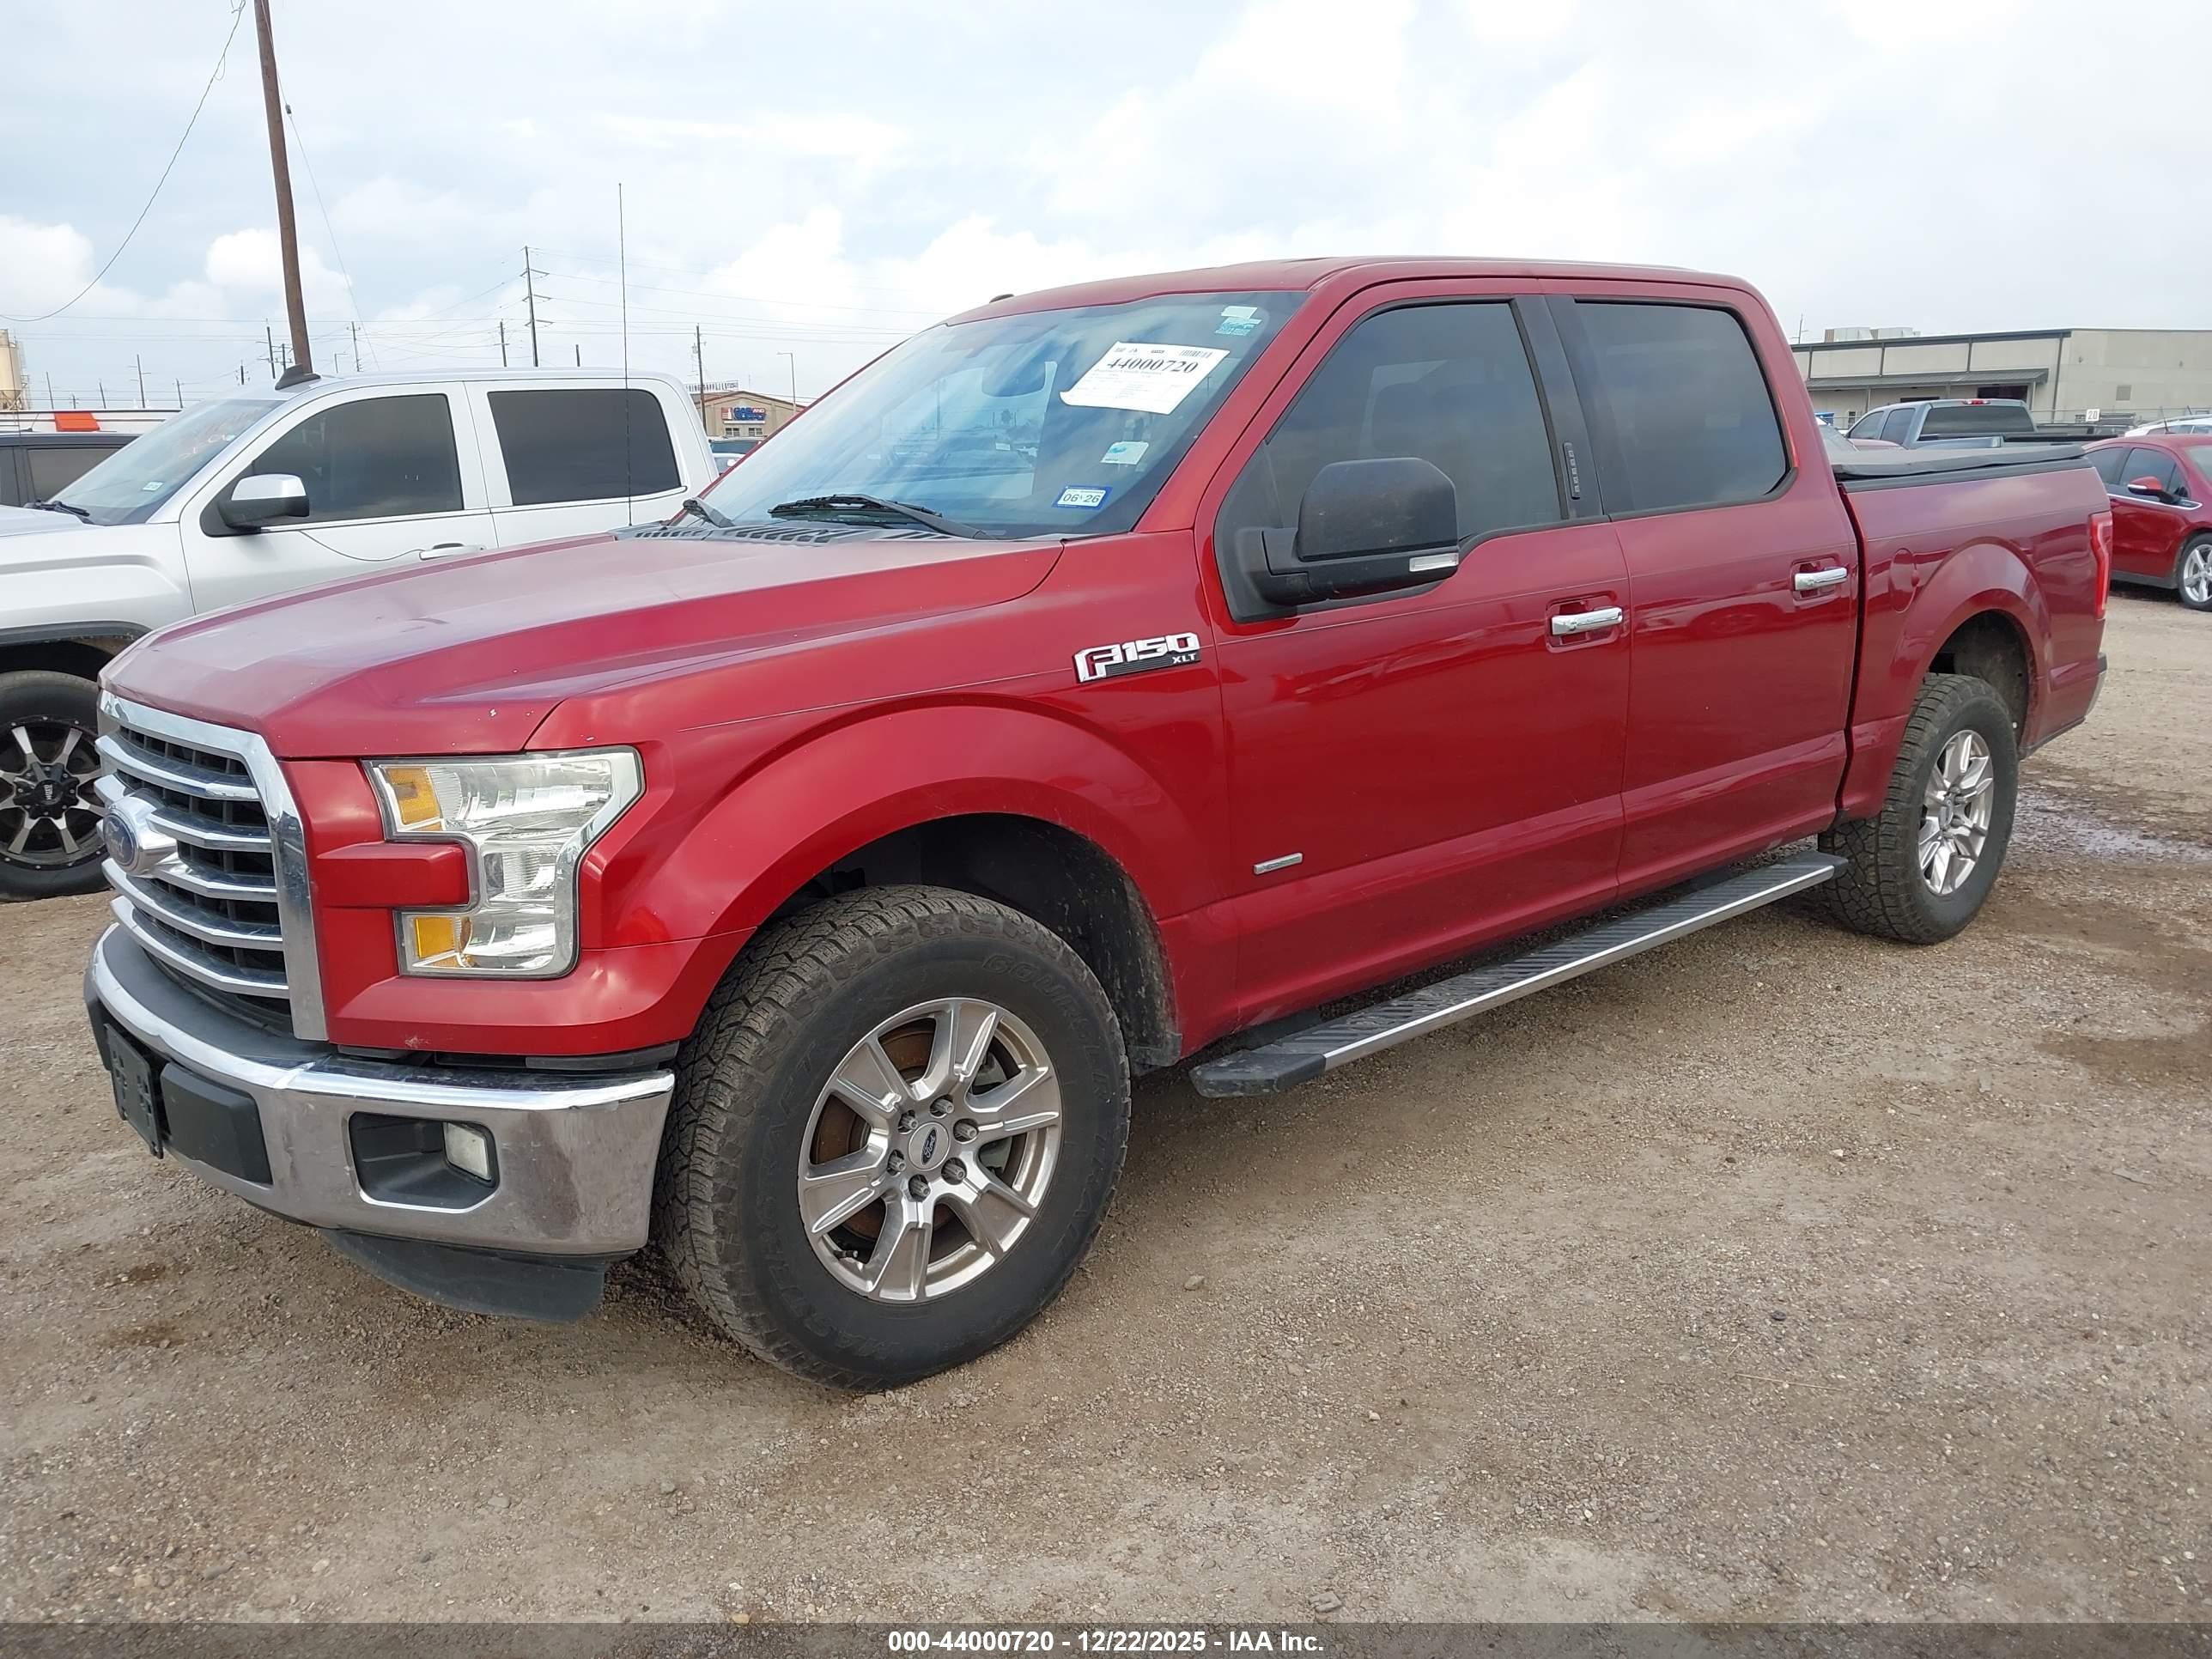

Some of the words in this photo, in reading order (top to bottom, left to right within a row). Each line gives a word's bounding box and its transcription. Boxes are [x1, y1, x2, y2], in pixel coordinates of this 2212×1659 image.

[1106, 357, 1199, 374] 44000720
[2087, 410, 2098, 420] 20
[1063, 493, 1079, 502] 06
[1083, 494, 1101, 503] 26
[1172, 653, 1197, 665] XLT
